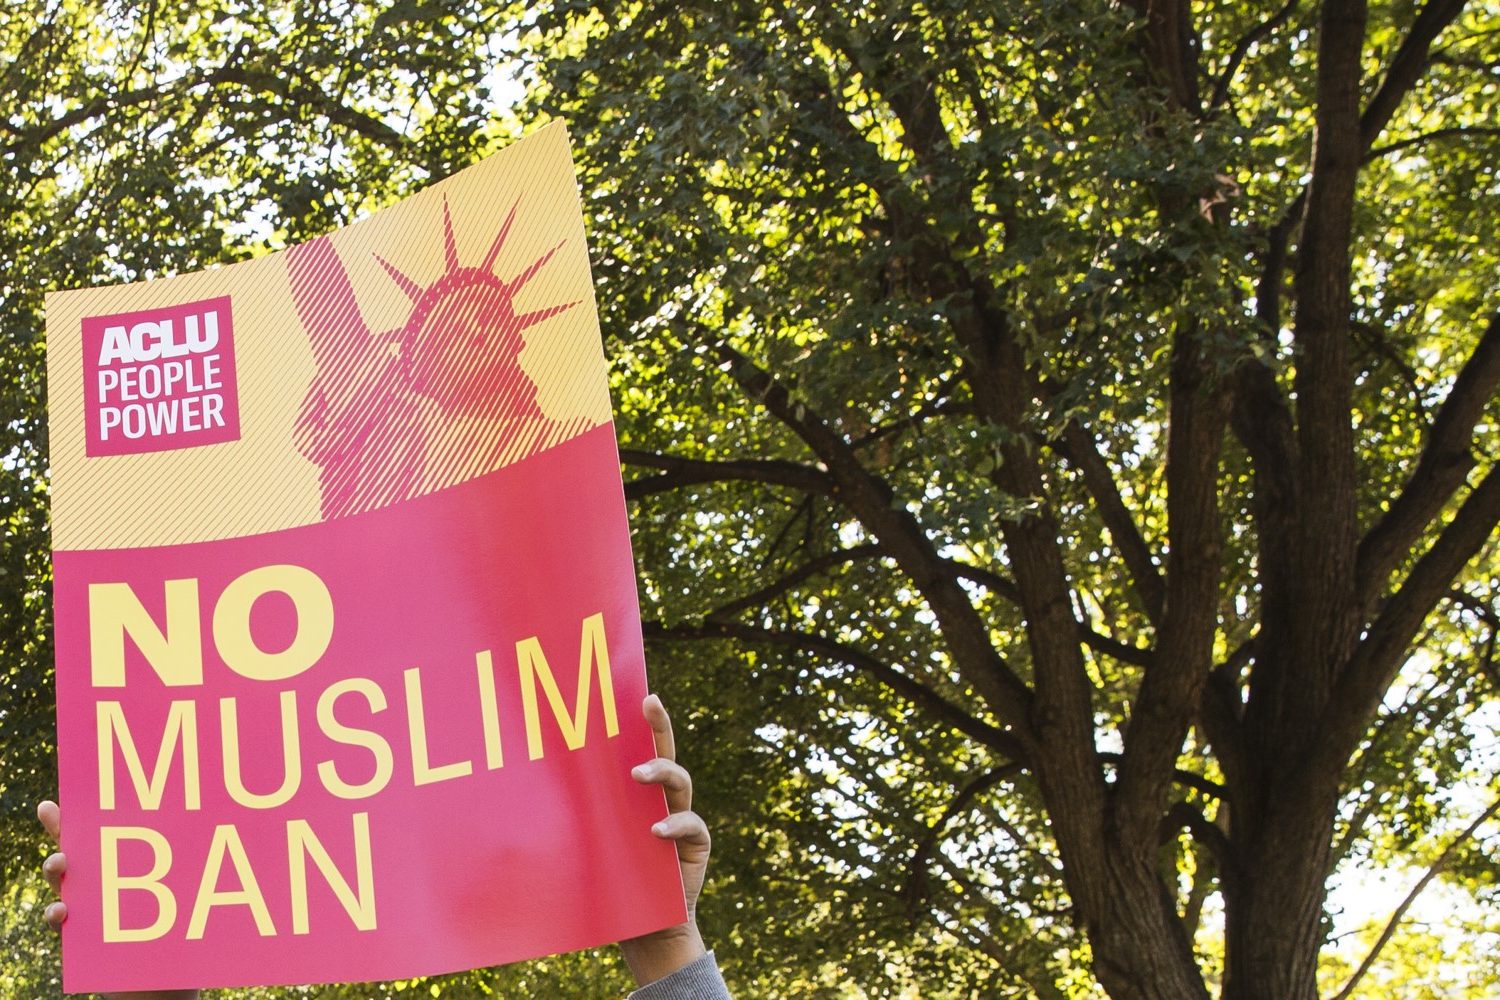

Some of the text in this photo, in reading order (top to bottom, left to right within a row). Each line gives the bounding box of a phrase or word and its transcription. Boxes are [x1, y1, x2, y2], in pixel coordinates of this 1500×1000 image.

[97, 310, 219, 366] ACLU
[97, 354, 222, 403] PEOPLE
[99, 393, 226, 441] POWER
[88, 564, 335, 687] NO
[96, 611, 620, 811] MUSLIM
[100, 812, 378, 943] BAN
